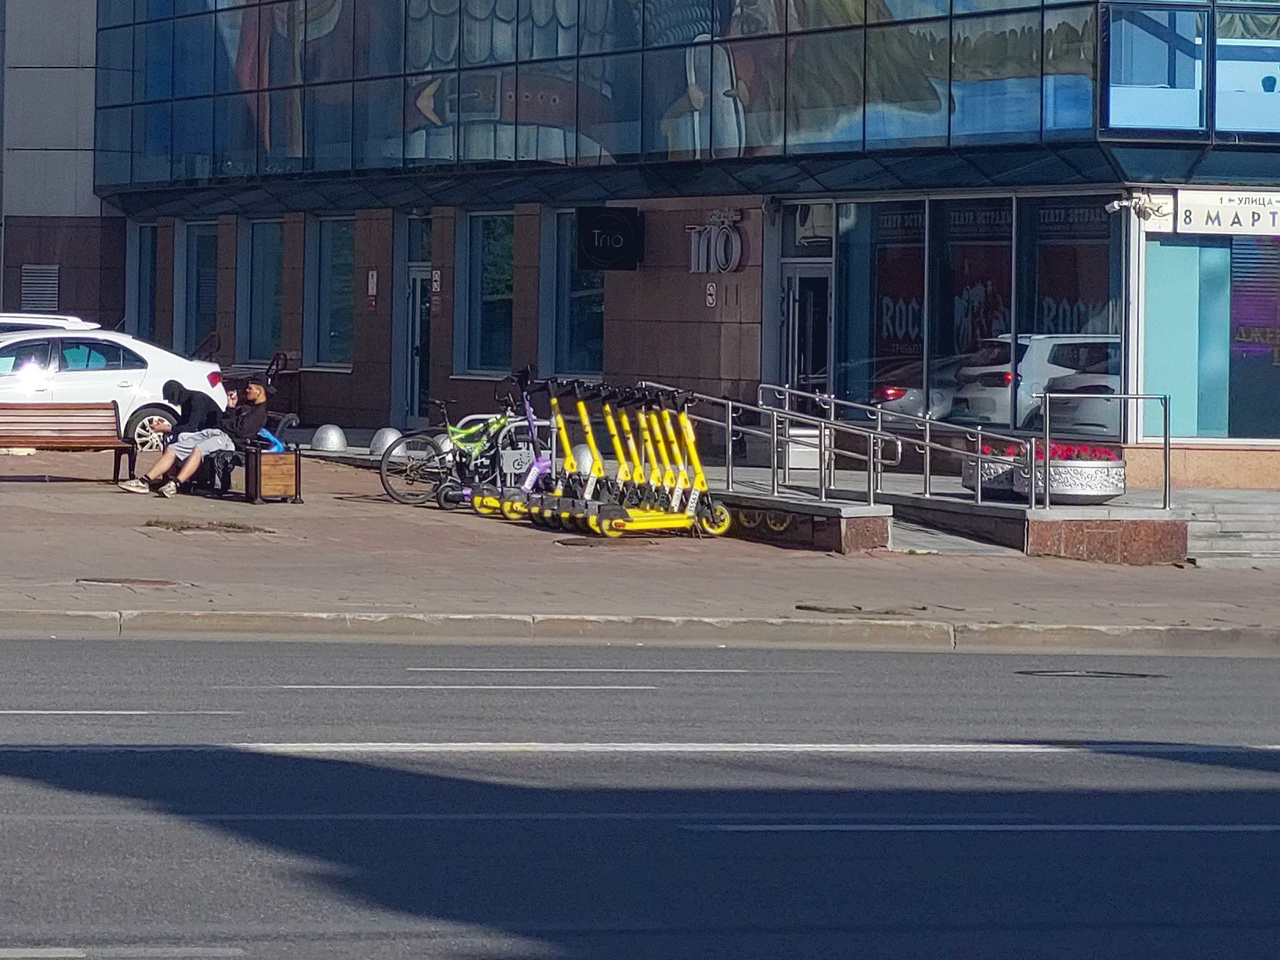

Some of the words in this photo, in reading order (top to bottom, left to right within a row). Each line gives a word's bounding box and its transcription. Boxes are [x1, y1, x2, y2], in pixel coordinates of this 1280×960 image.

[1237, 197, 1273, 207] УЛИЦА
[1183, 209, 1192, 225] 8
[1204, 210, 1279, 228] МАРТ
[592, 230, 624, 248] Trio
